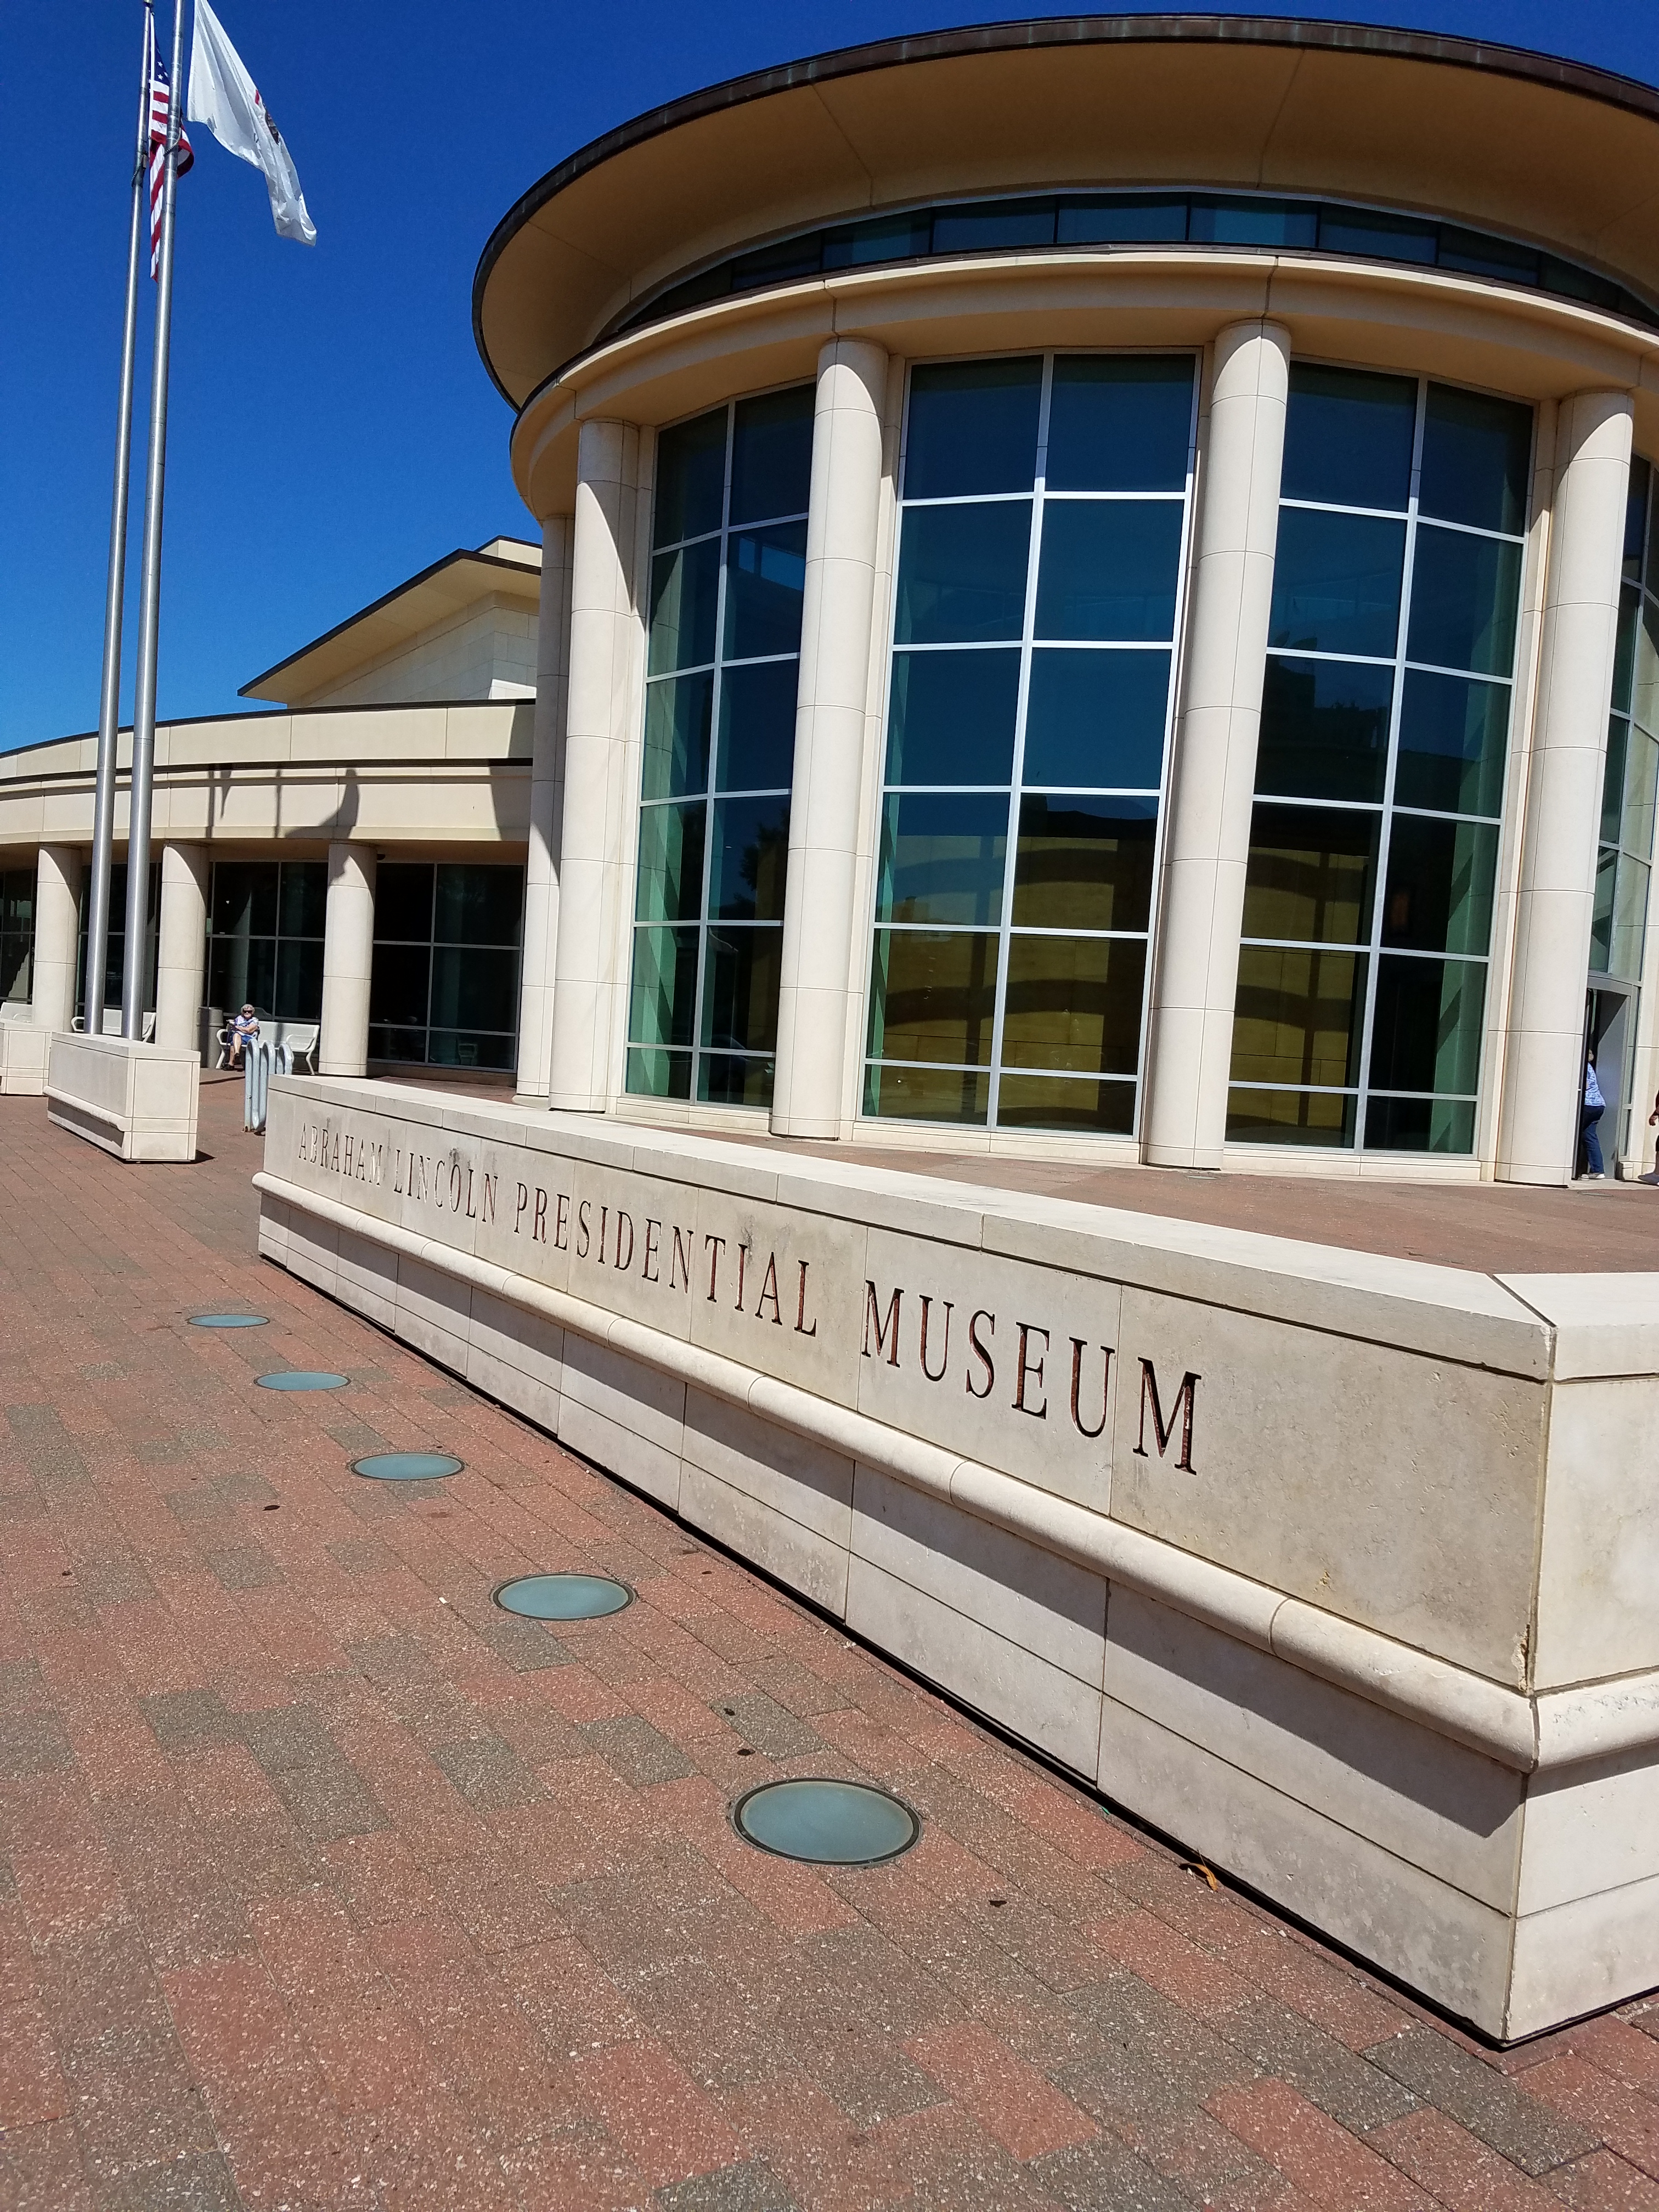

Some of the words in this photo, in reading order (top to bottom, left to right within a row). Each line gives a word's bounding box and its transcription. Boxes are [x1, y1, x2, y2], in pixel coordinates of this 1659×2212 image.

[298, 1123, 382, 1186] ABRAHAM
[393, 1149, 498, 1226] LINCOLN
[514, 1182, 817, 1337] PRESIDENTIAL
[861, 1279, 1202, 1475] MUSEUM
